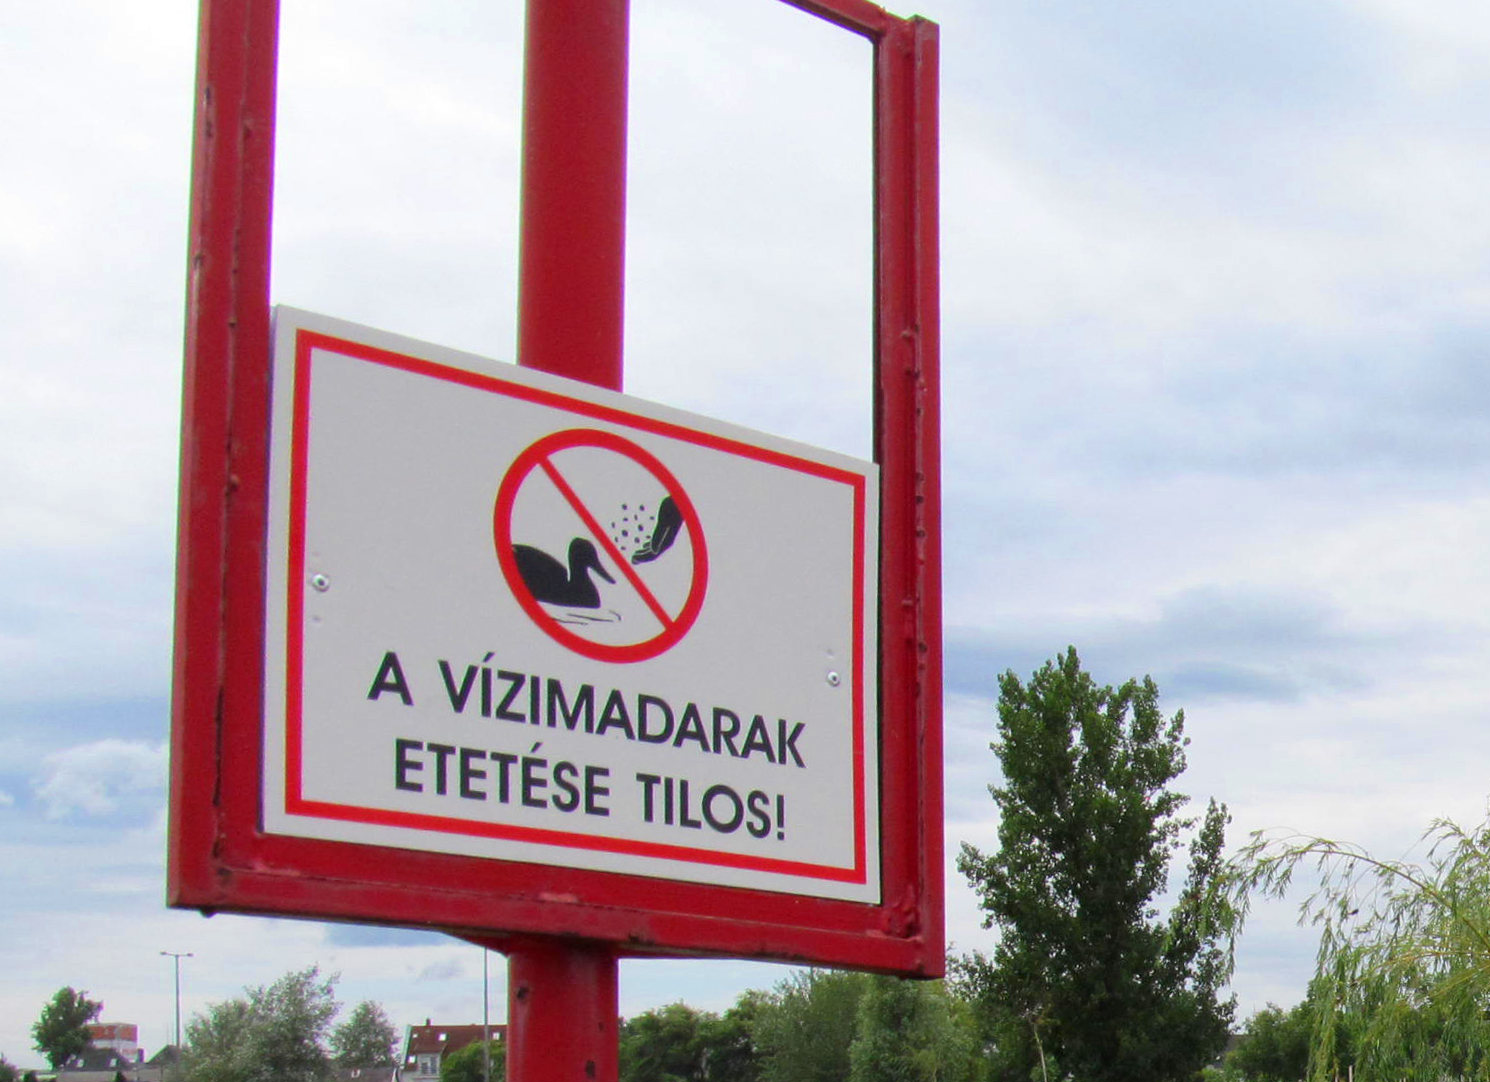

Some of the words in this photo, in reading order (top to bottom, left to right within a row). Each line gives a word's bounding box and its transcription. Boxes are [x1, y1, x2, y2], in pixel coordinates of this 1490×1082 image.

[367, 651, 414, 706] A
[438, 651, 806, 769] VÍZIMADARAK
[394, 738, 611, 817] ETETÉSE
[636, 772, 786, 841] TILOS!
